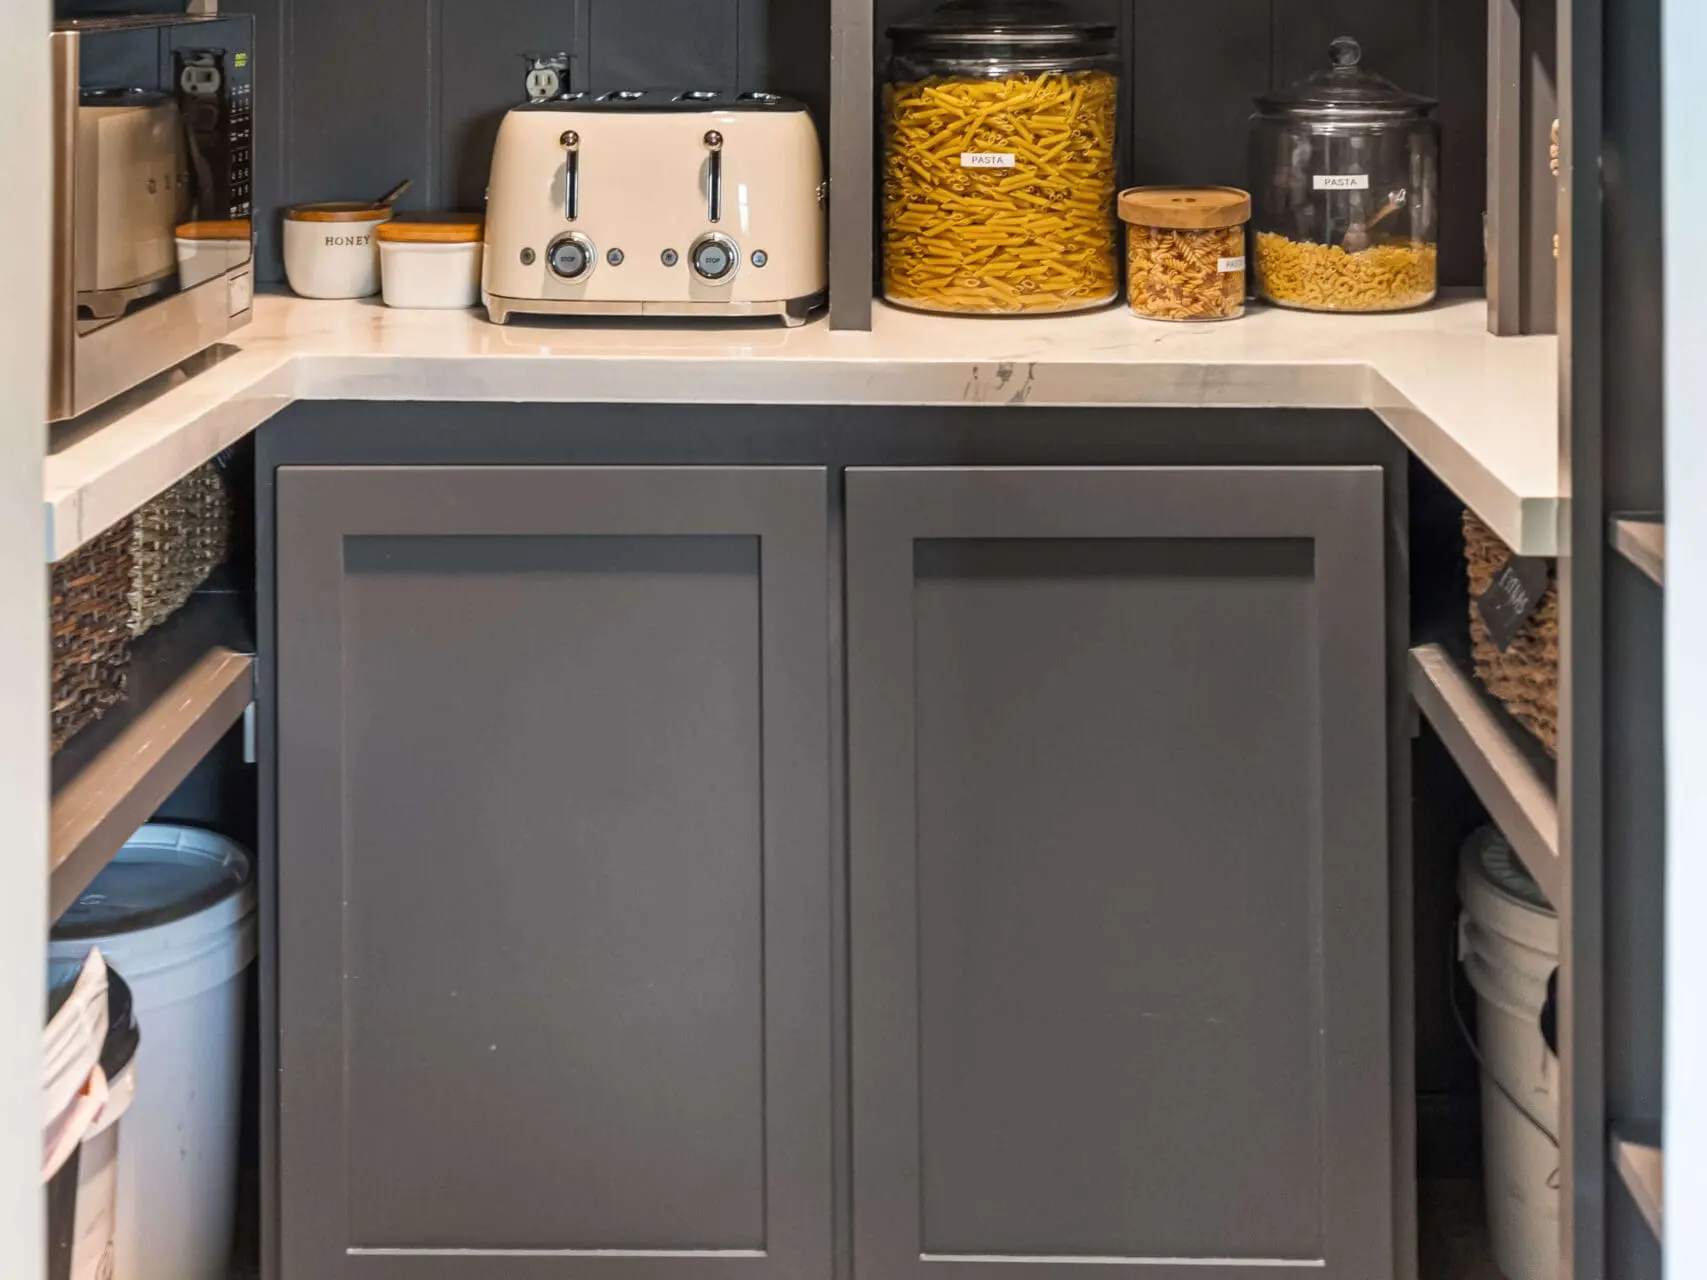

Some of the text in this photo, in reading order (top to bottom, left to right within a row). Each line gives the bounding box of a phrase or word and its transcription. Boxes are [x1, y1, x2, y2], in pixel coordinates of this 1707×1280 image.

[971, 156, 1005, 164] PASTA
[1324, 178, 1358, 186] PASTA
[325, 235, 371, 246] HONEY
